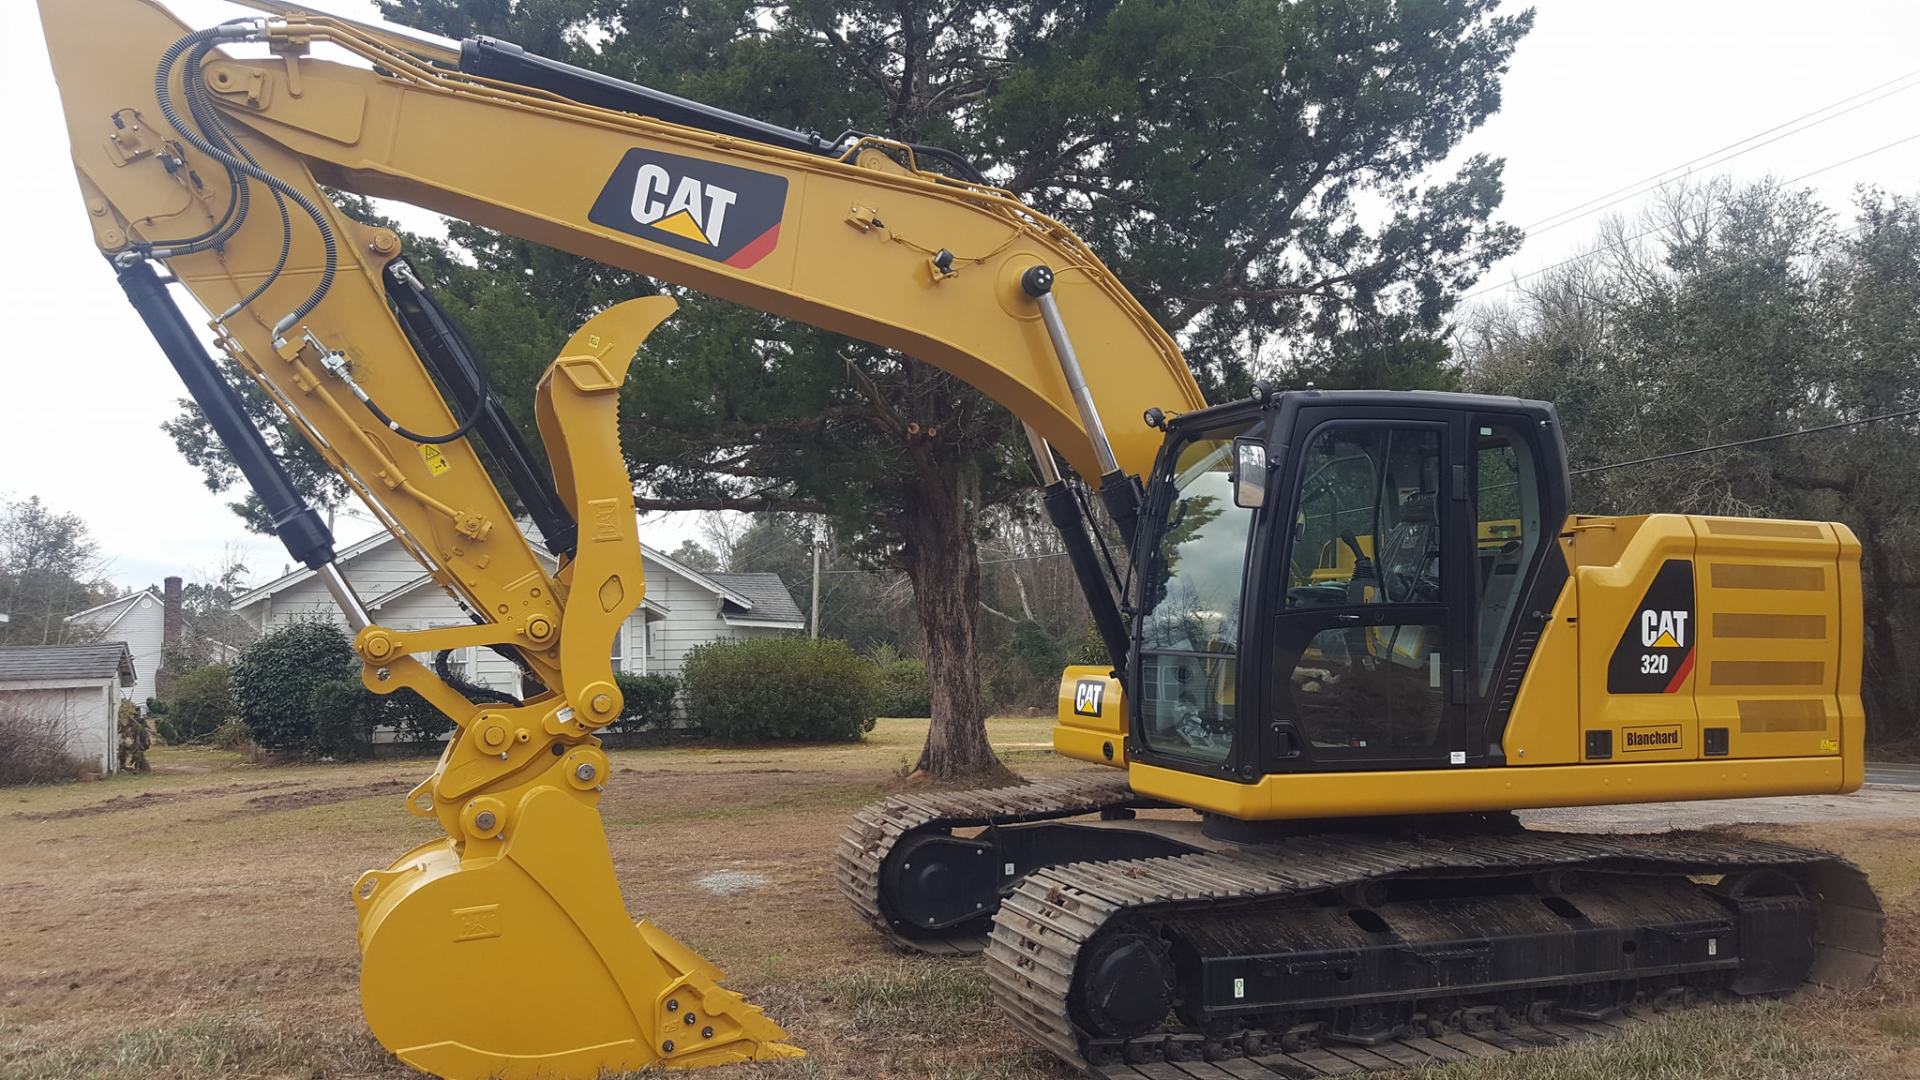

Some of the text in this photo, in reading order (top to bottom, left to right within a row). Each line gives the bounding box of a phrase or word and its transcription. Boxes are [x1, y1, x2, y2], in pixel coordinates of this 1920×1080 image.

[630, 163, 738, 248] CAT
[1641, 609, 1688, 648] CAT
[1640, 654, 1669, 674] 320
[1076, 683, 1103, 713] CAT
[1626, 730, 1678, 746] Blanchard
